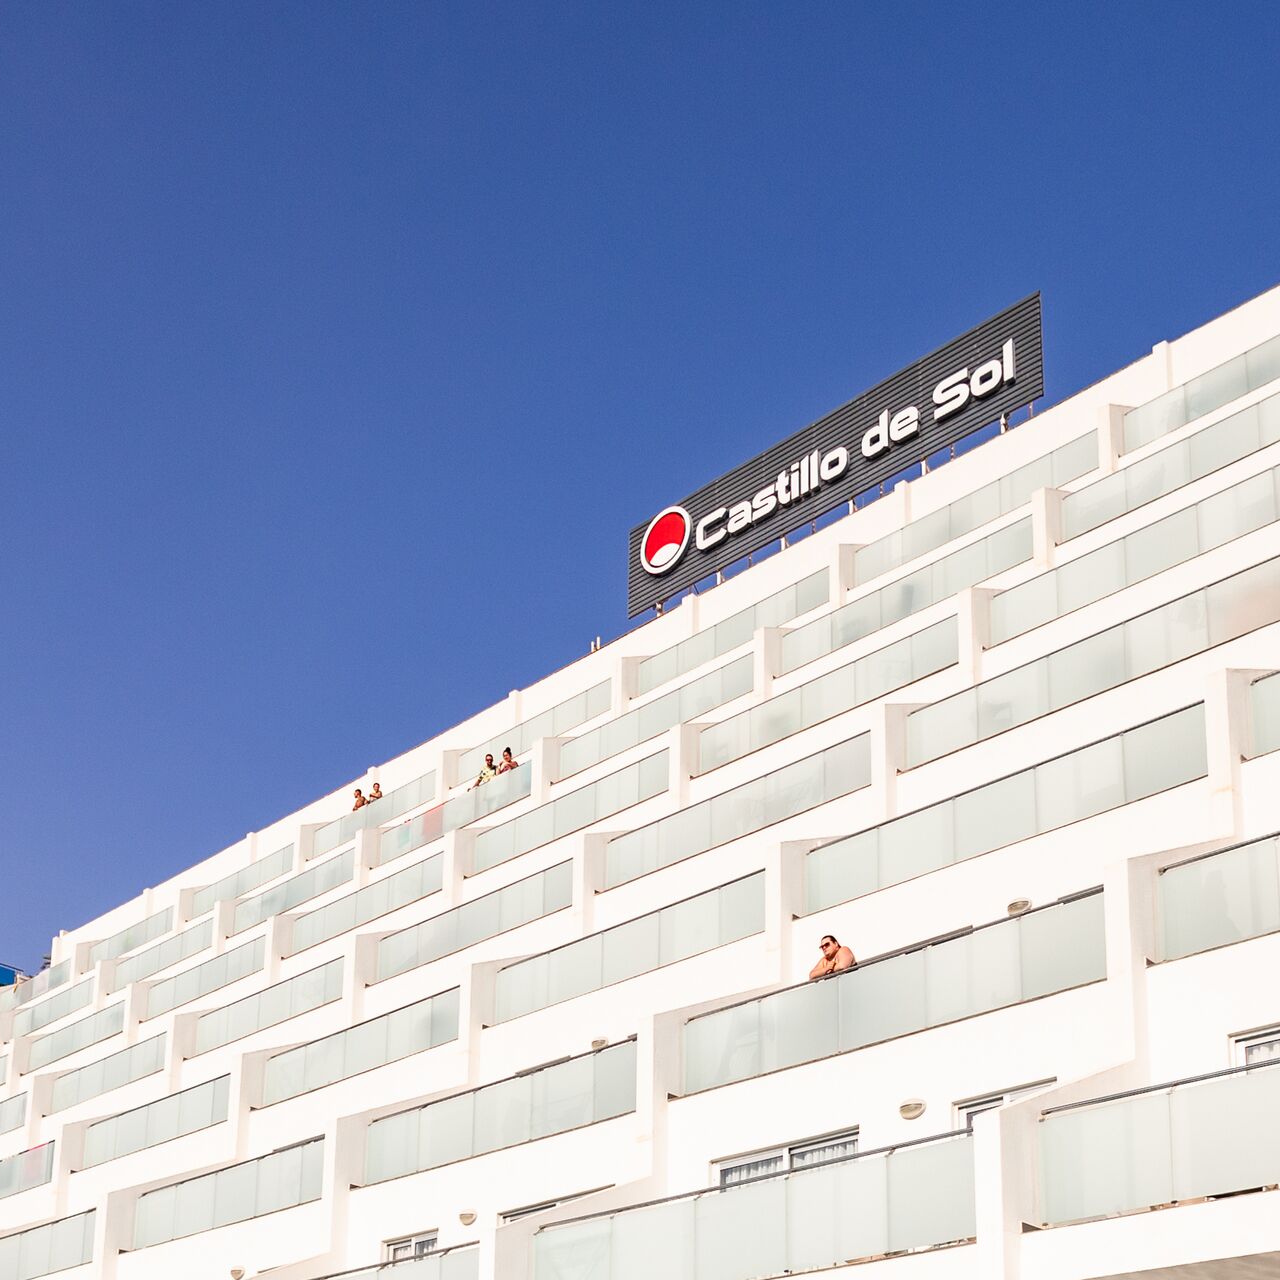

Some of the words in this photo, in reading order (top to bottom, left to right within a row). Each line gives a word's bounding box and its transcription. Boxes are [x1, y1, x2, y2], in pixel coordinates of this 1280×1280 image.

[695, 446, 849, 551] Castillo
[861, 405, 920, 460] de
[932, 337, 1017, 421] Sol
